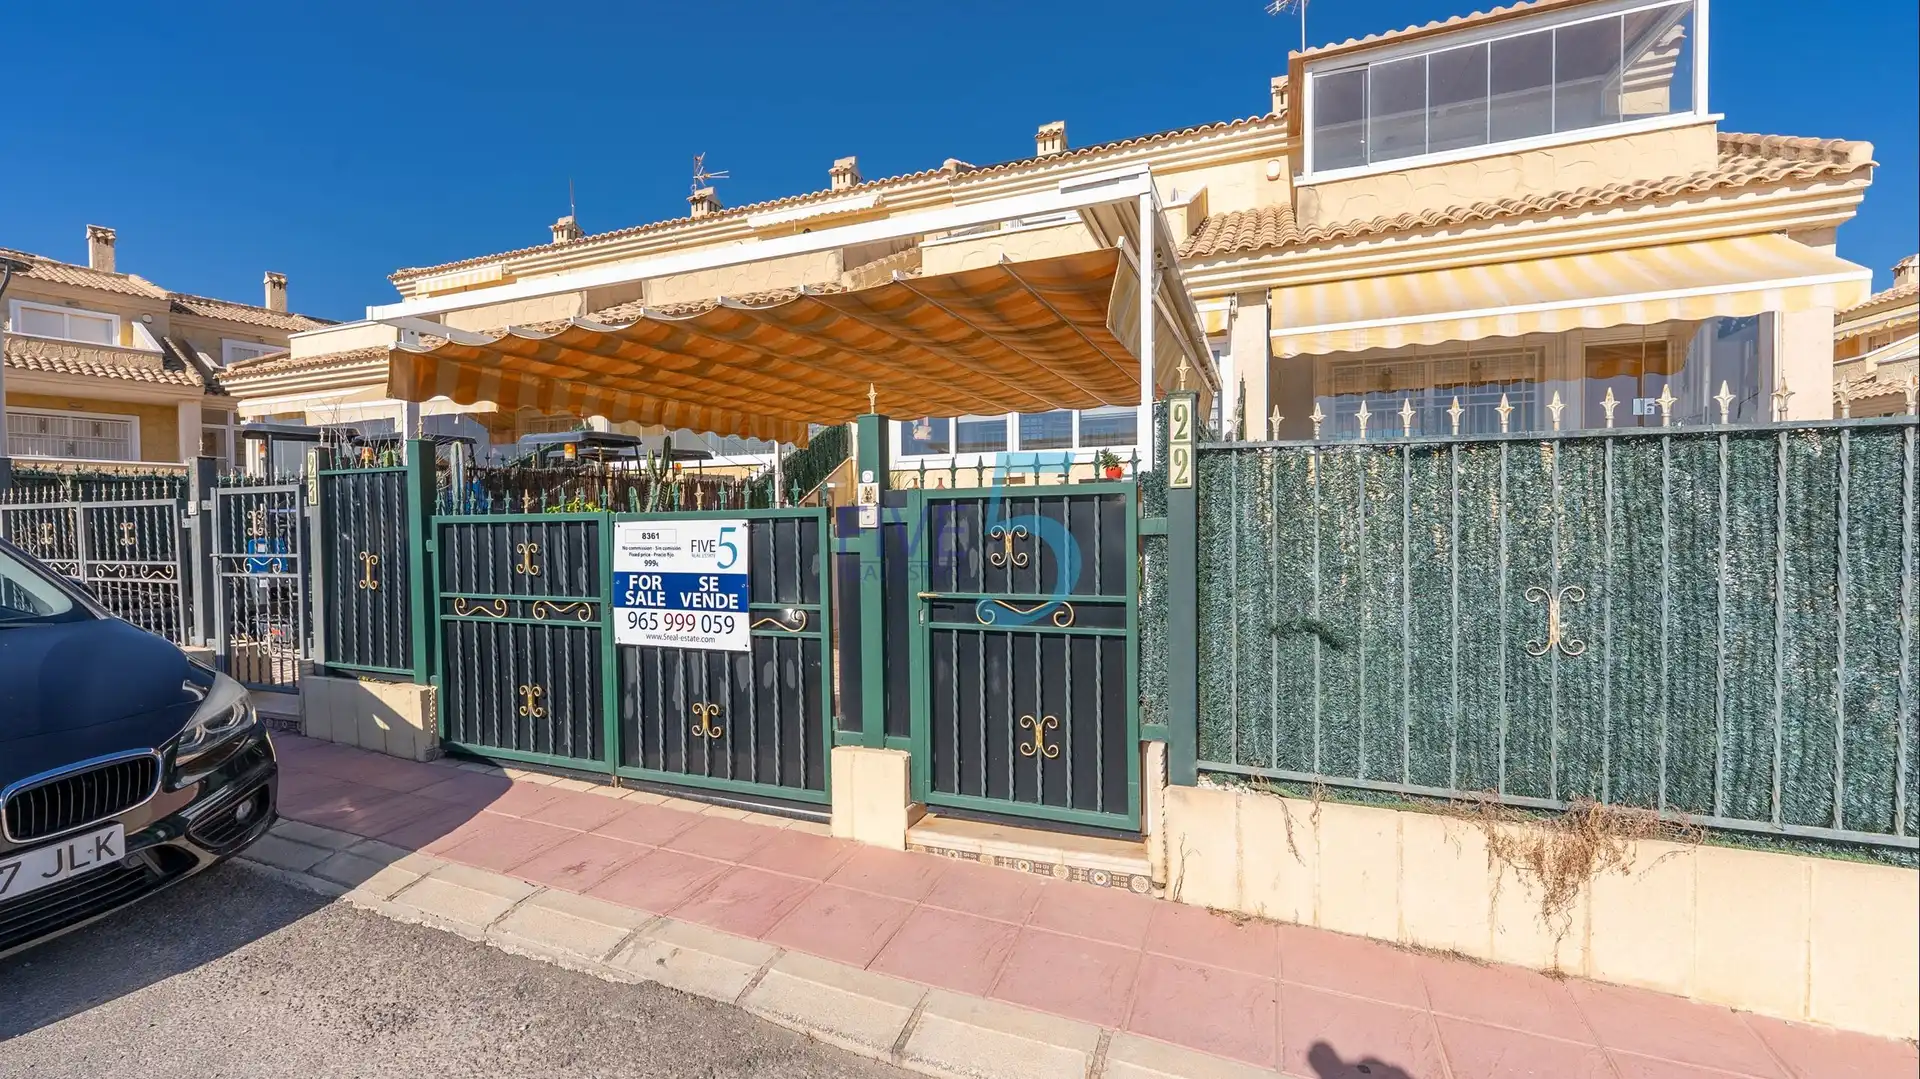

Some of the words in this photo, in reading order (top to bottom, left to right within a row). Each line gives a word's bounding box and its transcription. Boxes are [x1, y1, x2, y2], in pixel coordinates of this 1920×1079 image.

[1173, 403, 1188, 484] 22
[641, 532, 660, 540] 8361
[691, 539, 716, 553] FIVE
[717, 526, 738, 570] 5
[629, 574, 662, 590] FOR
[699, 576, 719, 592] SE
[625, 591, 666, 606] SALE
[680, 592, 739, 609] VENDE
[628, 611, 658, 630] 965
[664, 613, 696, 632] 999
[701, 614, 735, 634] 059
[646, 633, 716, 643] www.5real-estate.com
[41, 831, 116, 878] JLK
